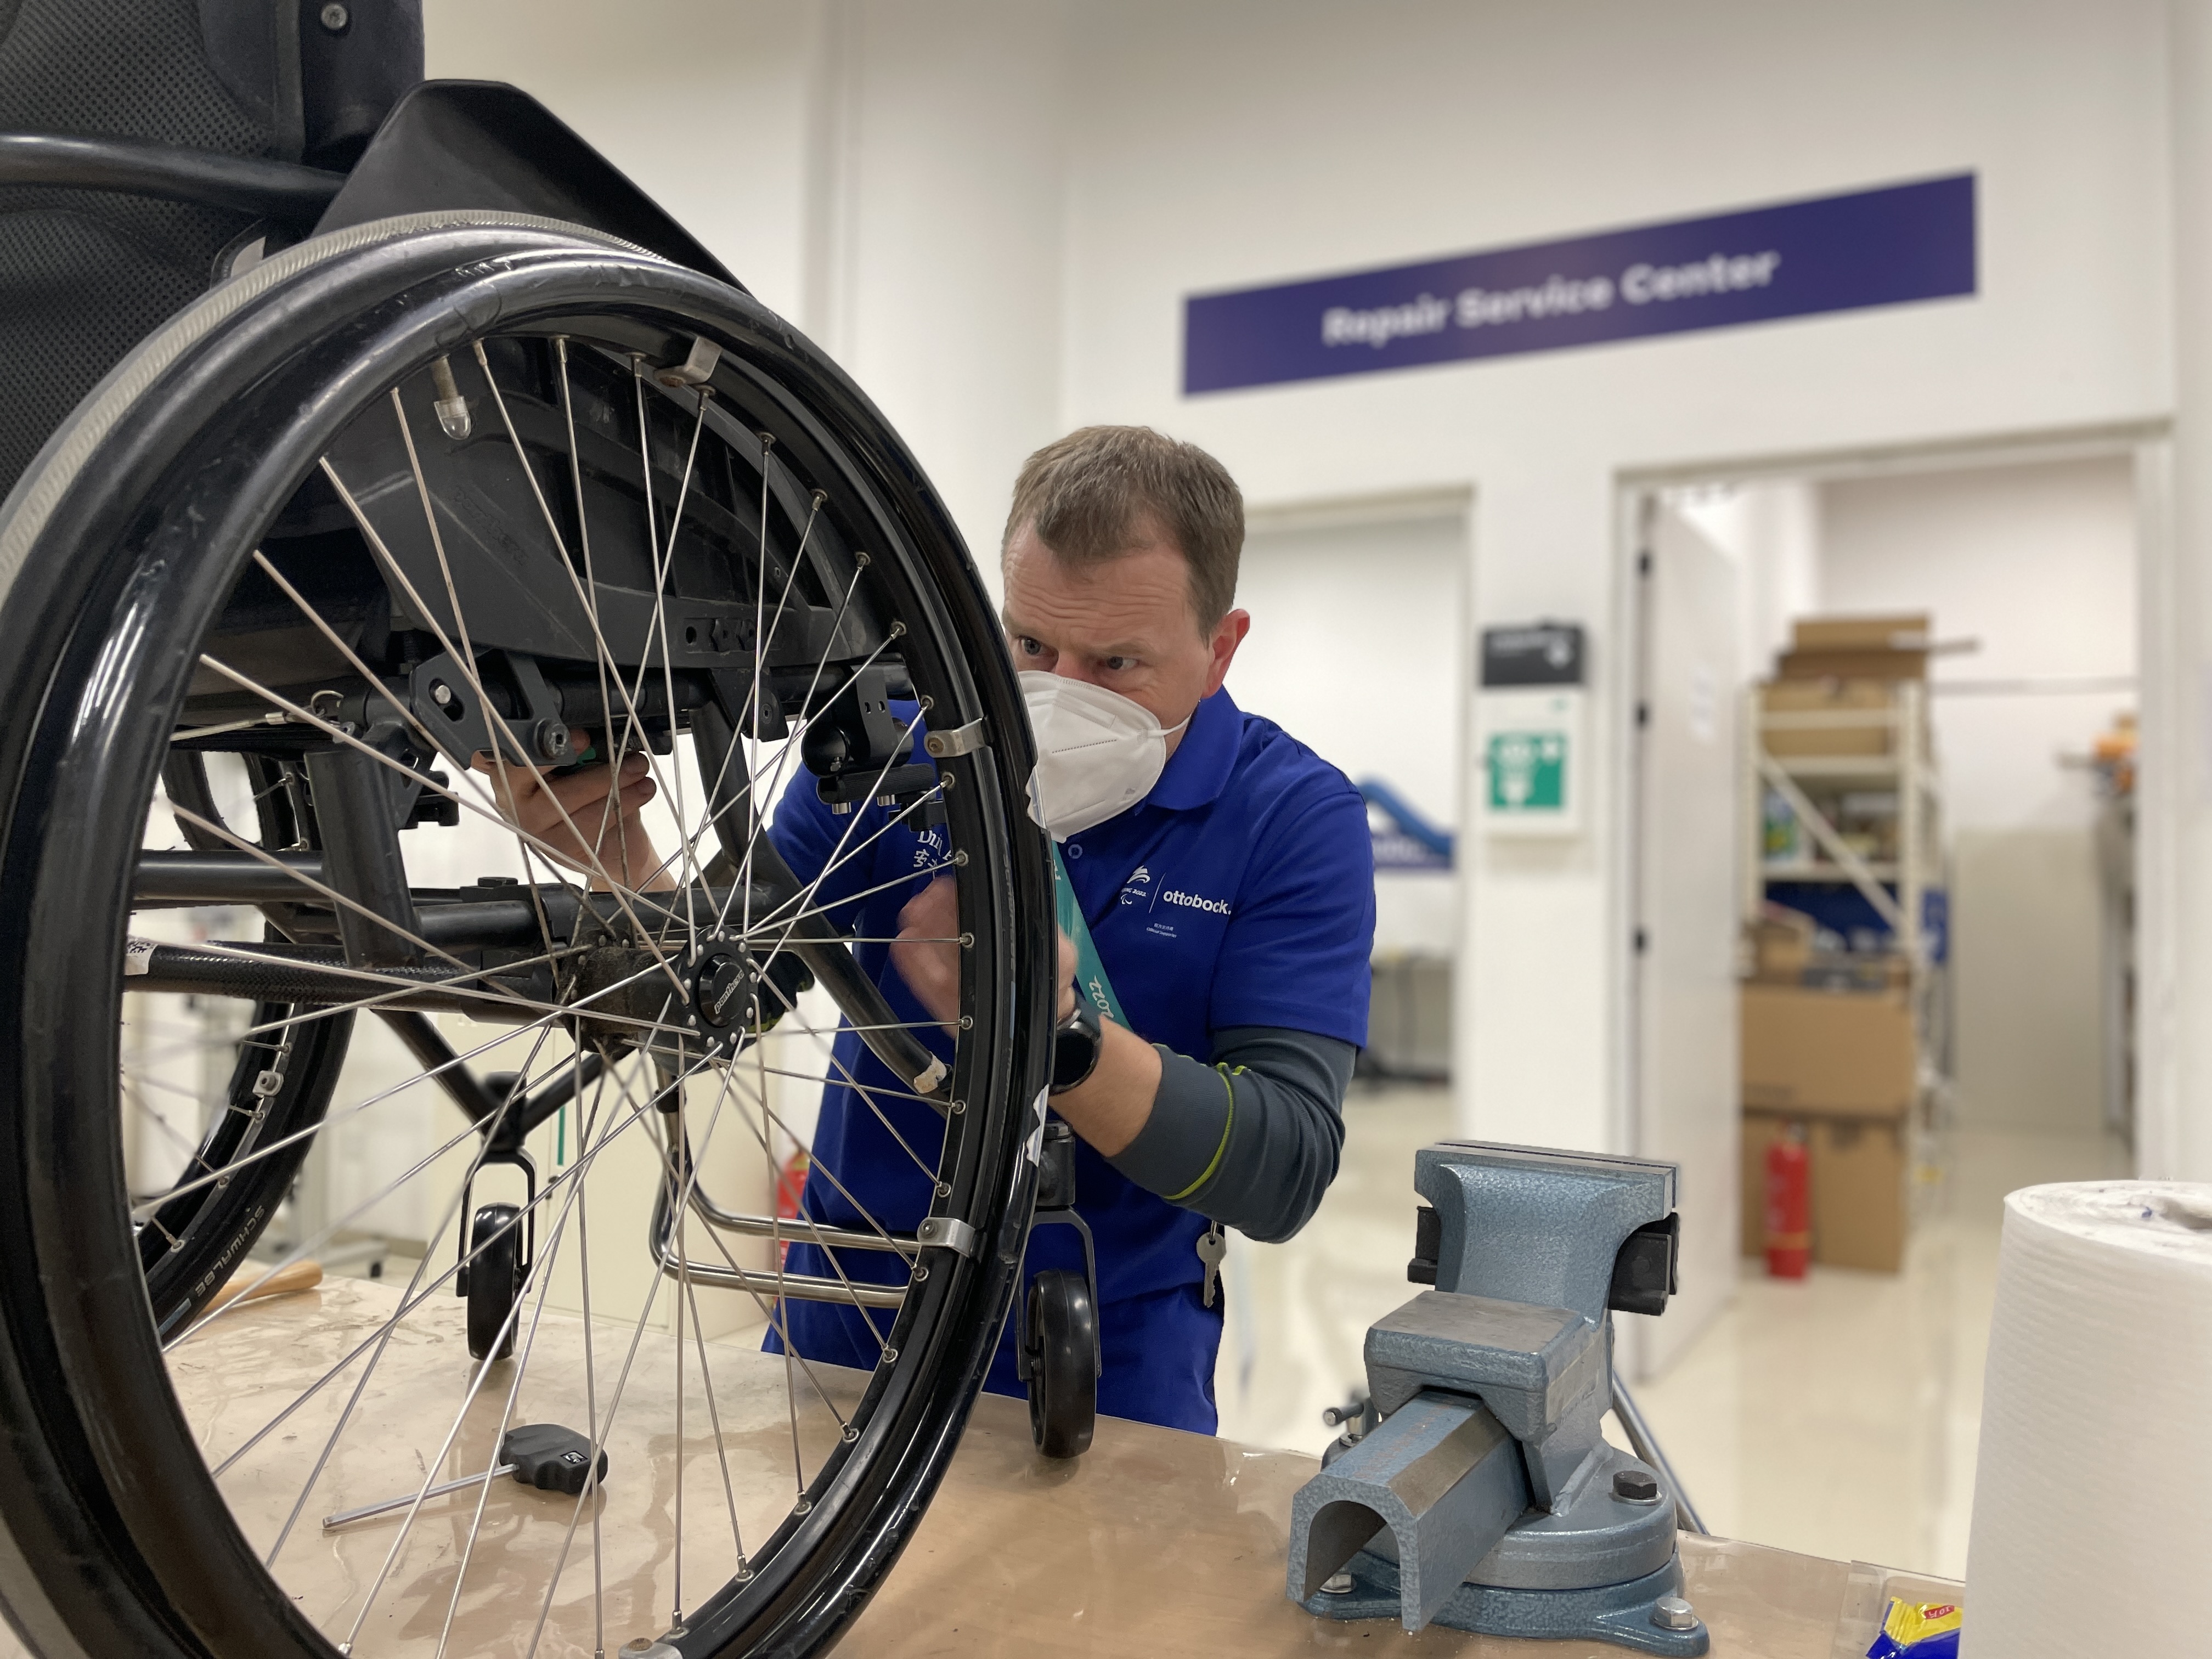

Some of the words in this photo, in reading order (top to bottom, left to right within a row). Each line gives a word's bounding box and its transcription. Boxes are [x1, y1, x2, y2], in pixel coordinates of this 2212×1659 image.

[1323, 292, 1452, 348] Repair
[1455, 274, 1615, 328] Service
[1620, 250, 1780, 304] Center
[195, 1205, 265, 1297] SCHWALBE
